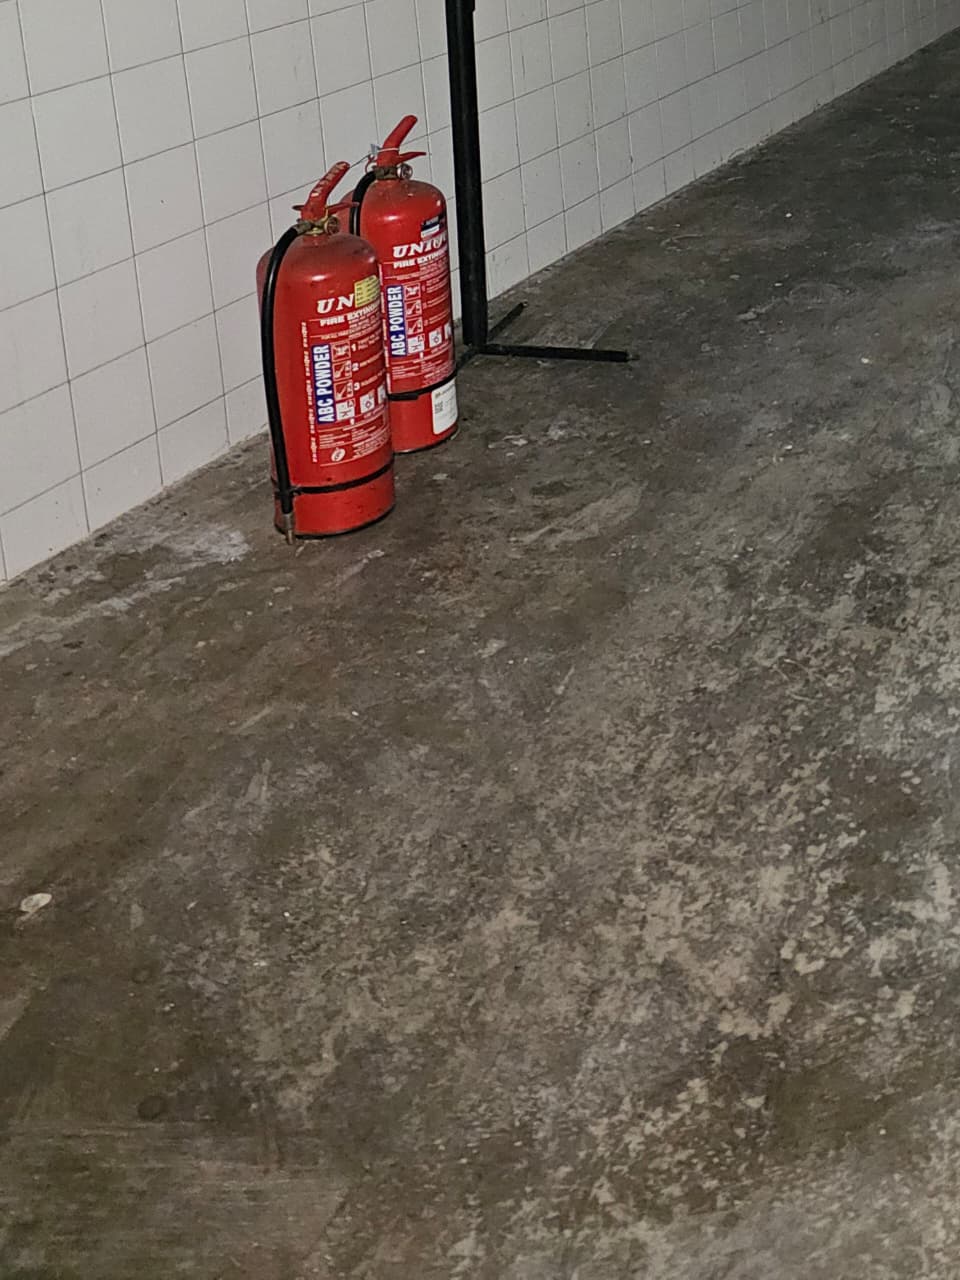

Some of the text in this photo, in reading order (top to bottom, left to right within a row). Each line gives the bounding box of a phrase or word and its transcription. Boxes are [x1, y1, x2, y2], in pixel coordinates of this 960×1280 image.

[387, 286, 406, 356] ABC POWDER
[313, 344, 335, 422] ABC POWDER
